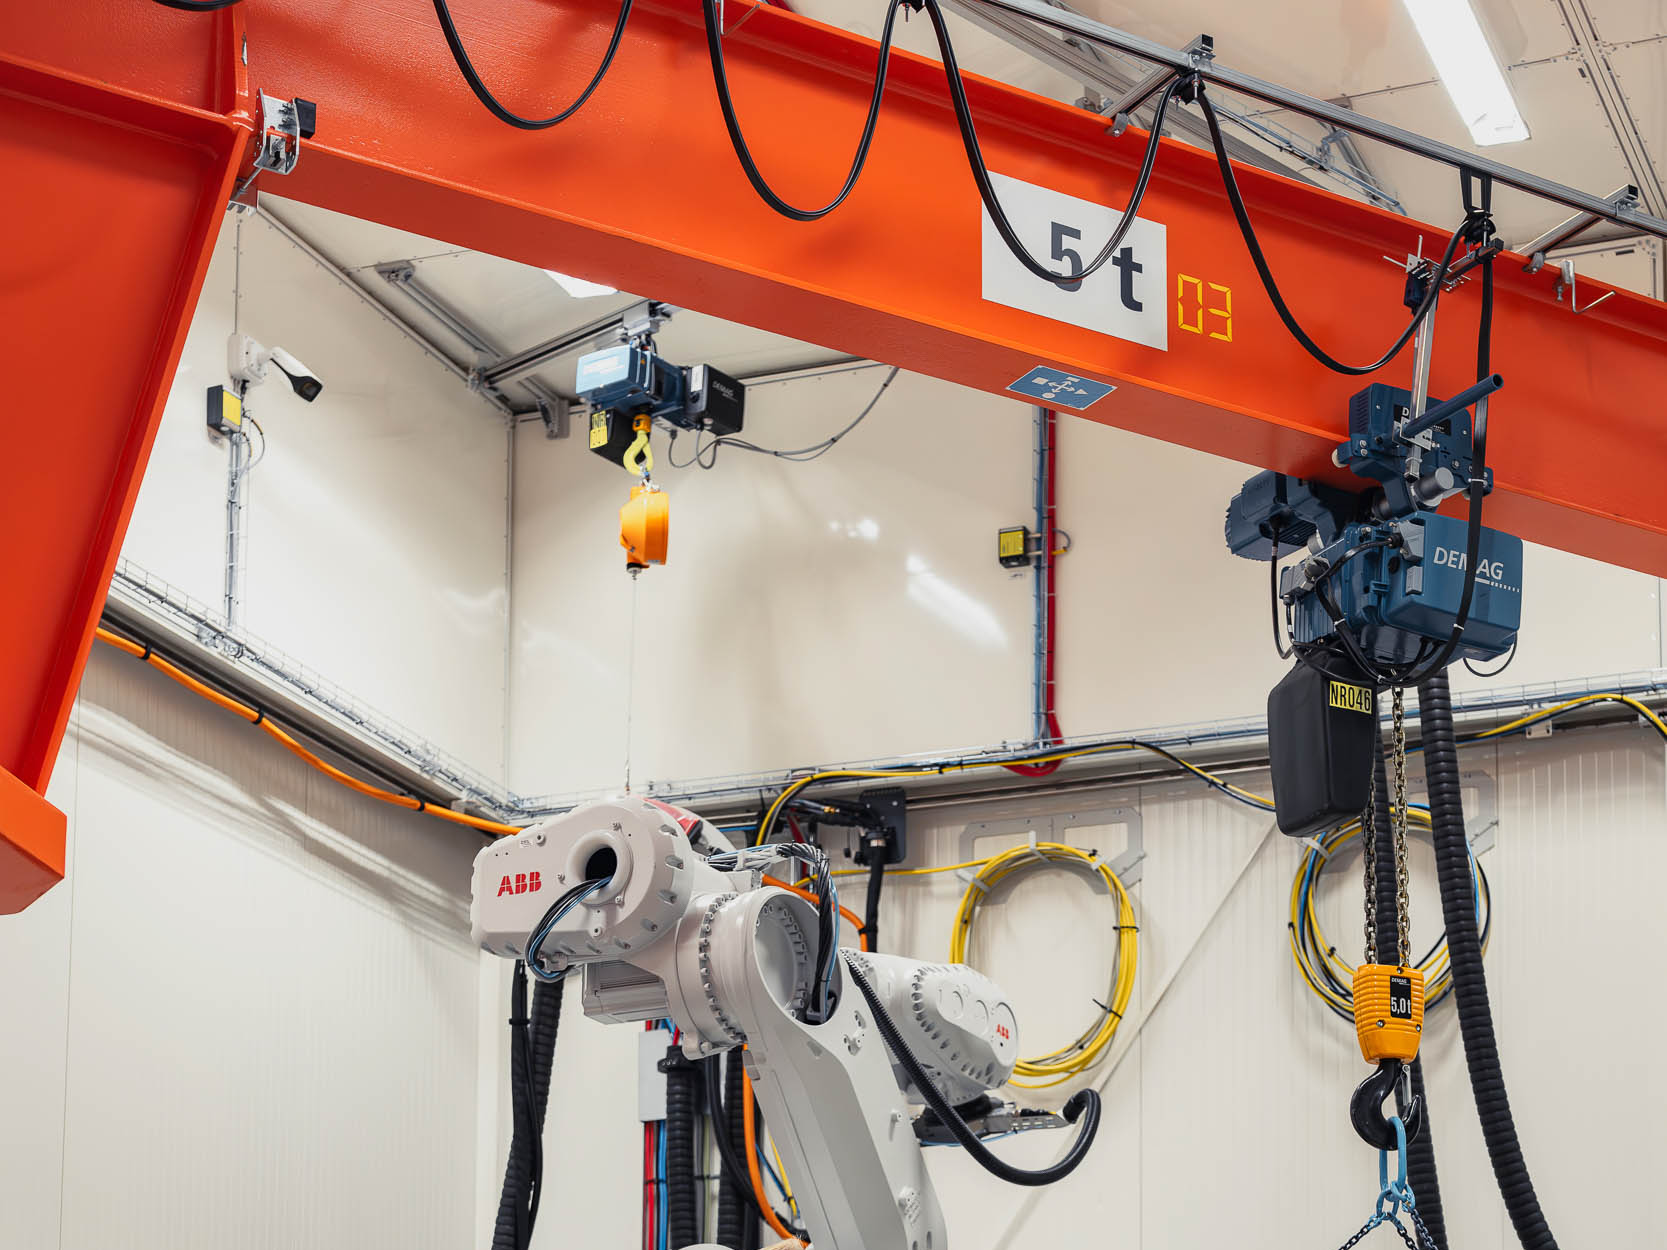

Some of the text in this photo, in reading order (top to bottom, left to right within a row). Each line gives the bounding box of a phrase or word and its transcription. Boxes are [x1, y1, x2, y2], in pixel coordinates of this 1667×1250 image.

[1050, 221, 1143, 312] 5 t
[1177, 273, 1232, 342] 03
[1330, 683, 1371, 712] NR046
[497, 871, 542, 897] ABB
[996, 1023, 1010, 1040] ABB
